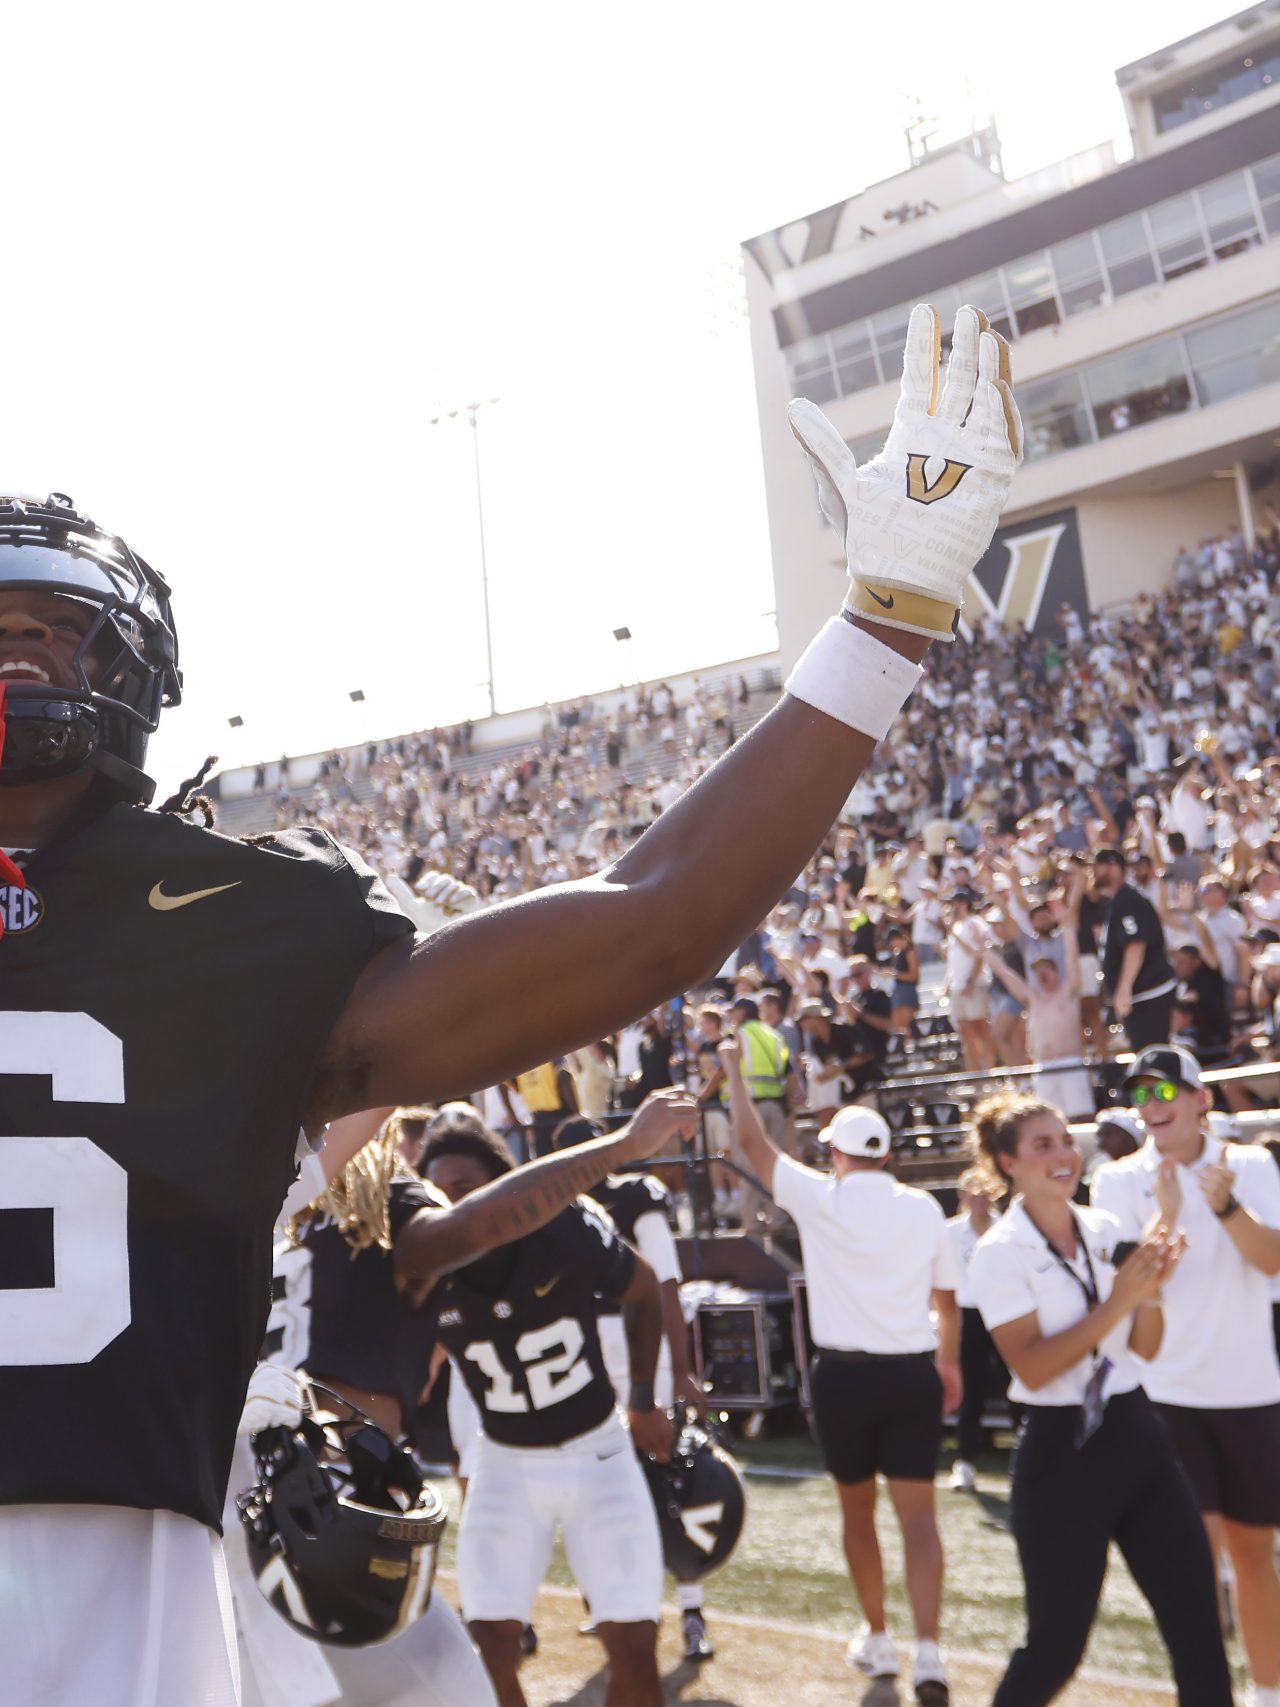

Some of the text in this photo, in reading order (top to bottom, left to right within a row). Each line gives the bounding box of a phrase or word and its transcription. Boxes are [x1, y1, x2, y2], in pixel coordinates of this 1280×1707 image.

[907, 453, 974, 505] V
[954, 523, 1067, 640] V
[464, 1317, 594, 1413] 12
